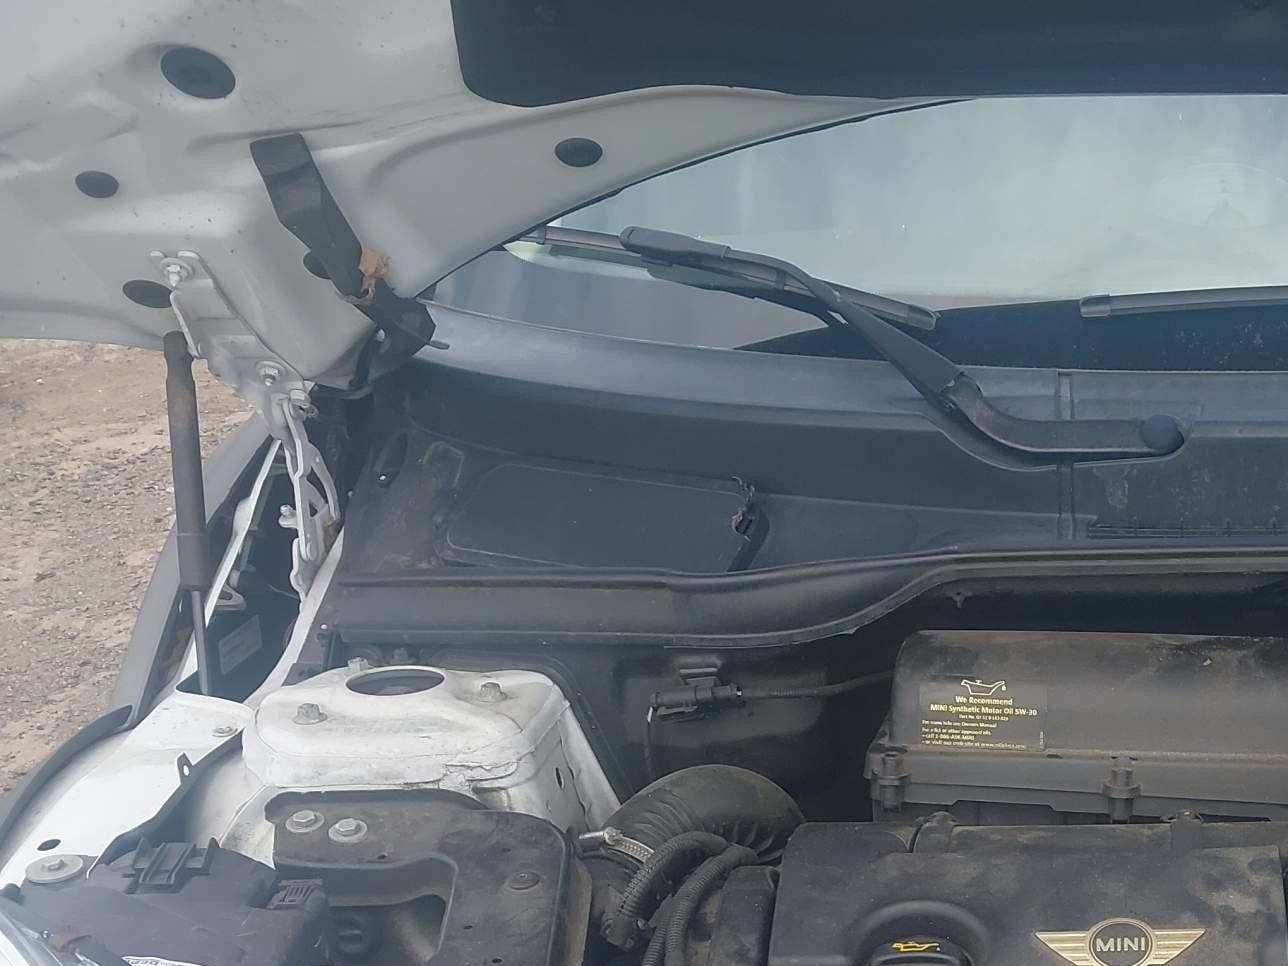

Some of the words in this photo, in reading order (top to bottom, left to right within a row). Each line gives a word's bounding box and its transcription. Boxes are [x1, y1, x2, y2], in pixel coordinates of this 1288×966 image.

[955, 695, 967, 703] We
[968, 696, 1013, 706] Recommend
[930, 703, 948, 711] MINI
[948, 704, 980, 714] Synthetic
[981, 705, 1002, 714] Motor
[1003, 706, 1014, 715] Oil
[1014, 707, 1038, 716] 5W-30
[1095, 936, 1146, 952] MINI
